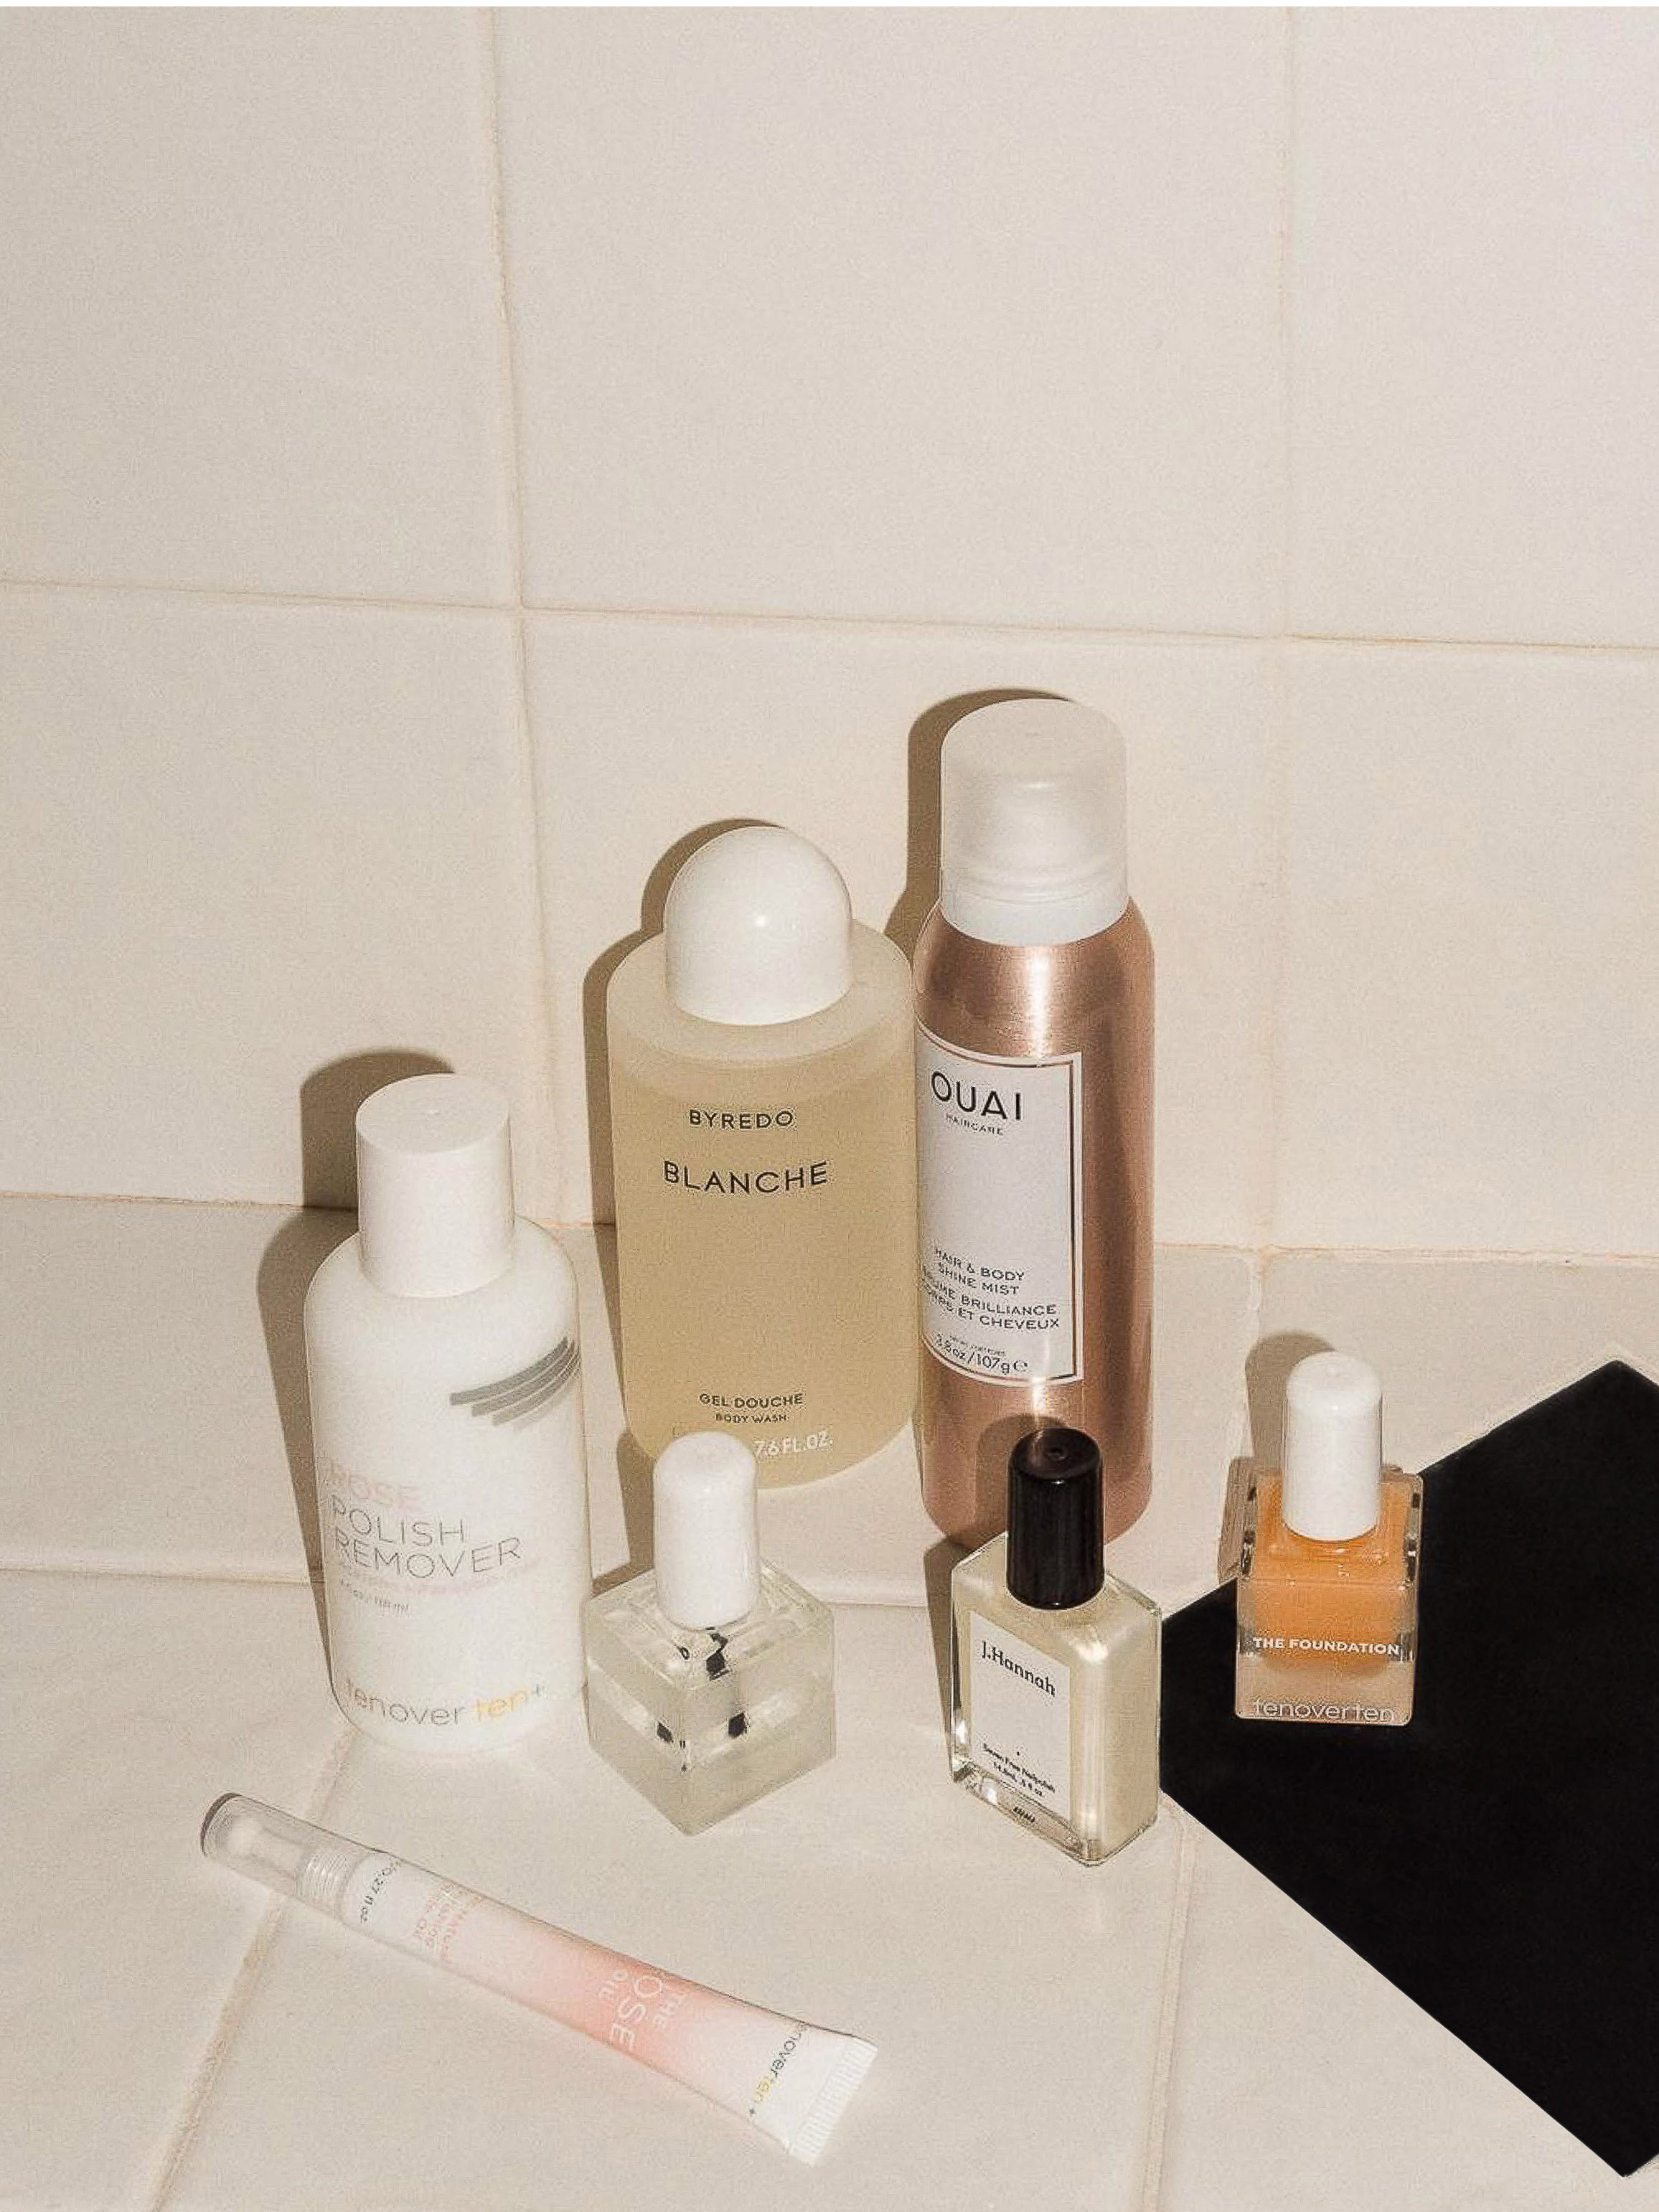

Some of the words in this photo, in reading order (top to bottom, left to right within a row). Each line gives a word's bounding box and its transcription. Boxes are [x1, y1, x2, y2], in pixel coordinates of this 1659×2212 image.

[931, 1070, 1021, 1120] OUAI
[689, 1108, 794, 1130] BYREDO
[664, 1159, 828, 1194] BLANCHE
[935, 1246, 962, 1269] HAIR
[980, 1267, 1025, 1281] BODY
[982, 1282, 1020, 1295] MIST
[962, 1294, 1057, 1316] BRILLIANCE
[958, 1307, 974, 1320] ET
[979, 1315, 1060, 1329] CHEVEUX
[699, 1393, 729, 1407] GEL
[733, 1393, 804, 1409] DOUCHE
[715, 1413, 749, 1423] BODY
[751, 1414, 789, 1423] WASH
[332, 1494, 464, 1546] POLISH
[335, 1527, 522, 1578] REMOVER
[1252, 1637, 1286, 1649] THE
[1289, 1639, 1400, 1656] FOUNDATION
[1254, 1699, 1395, 1722] tenoverten
[609, 1969, 666, 2051] OSE
